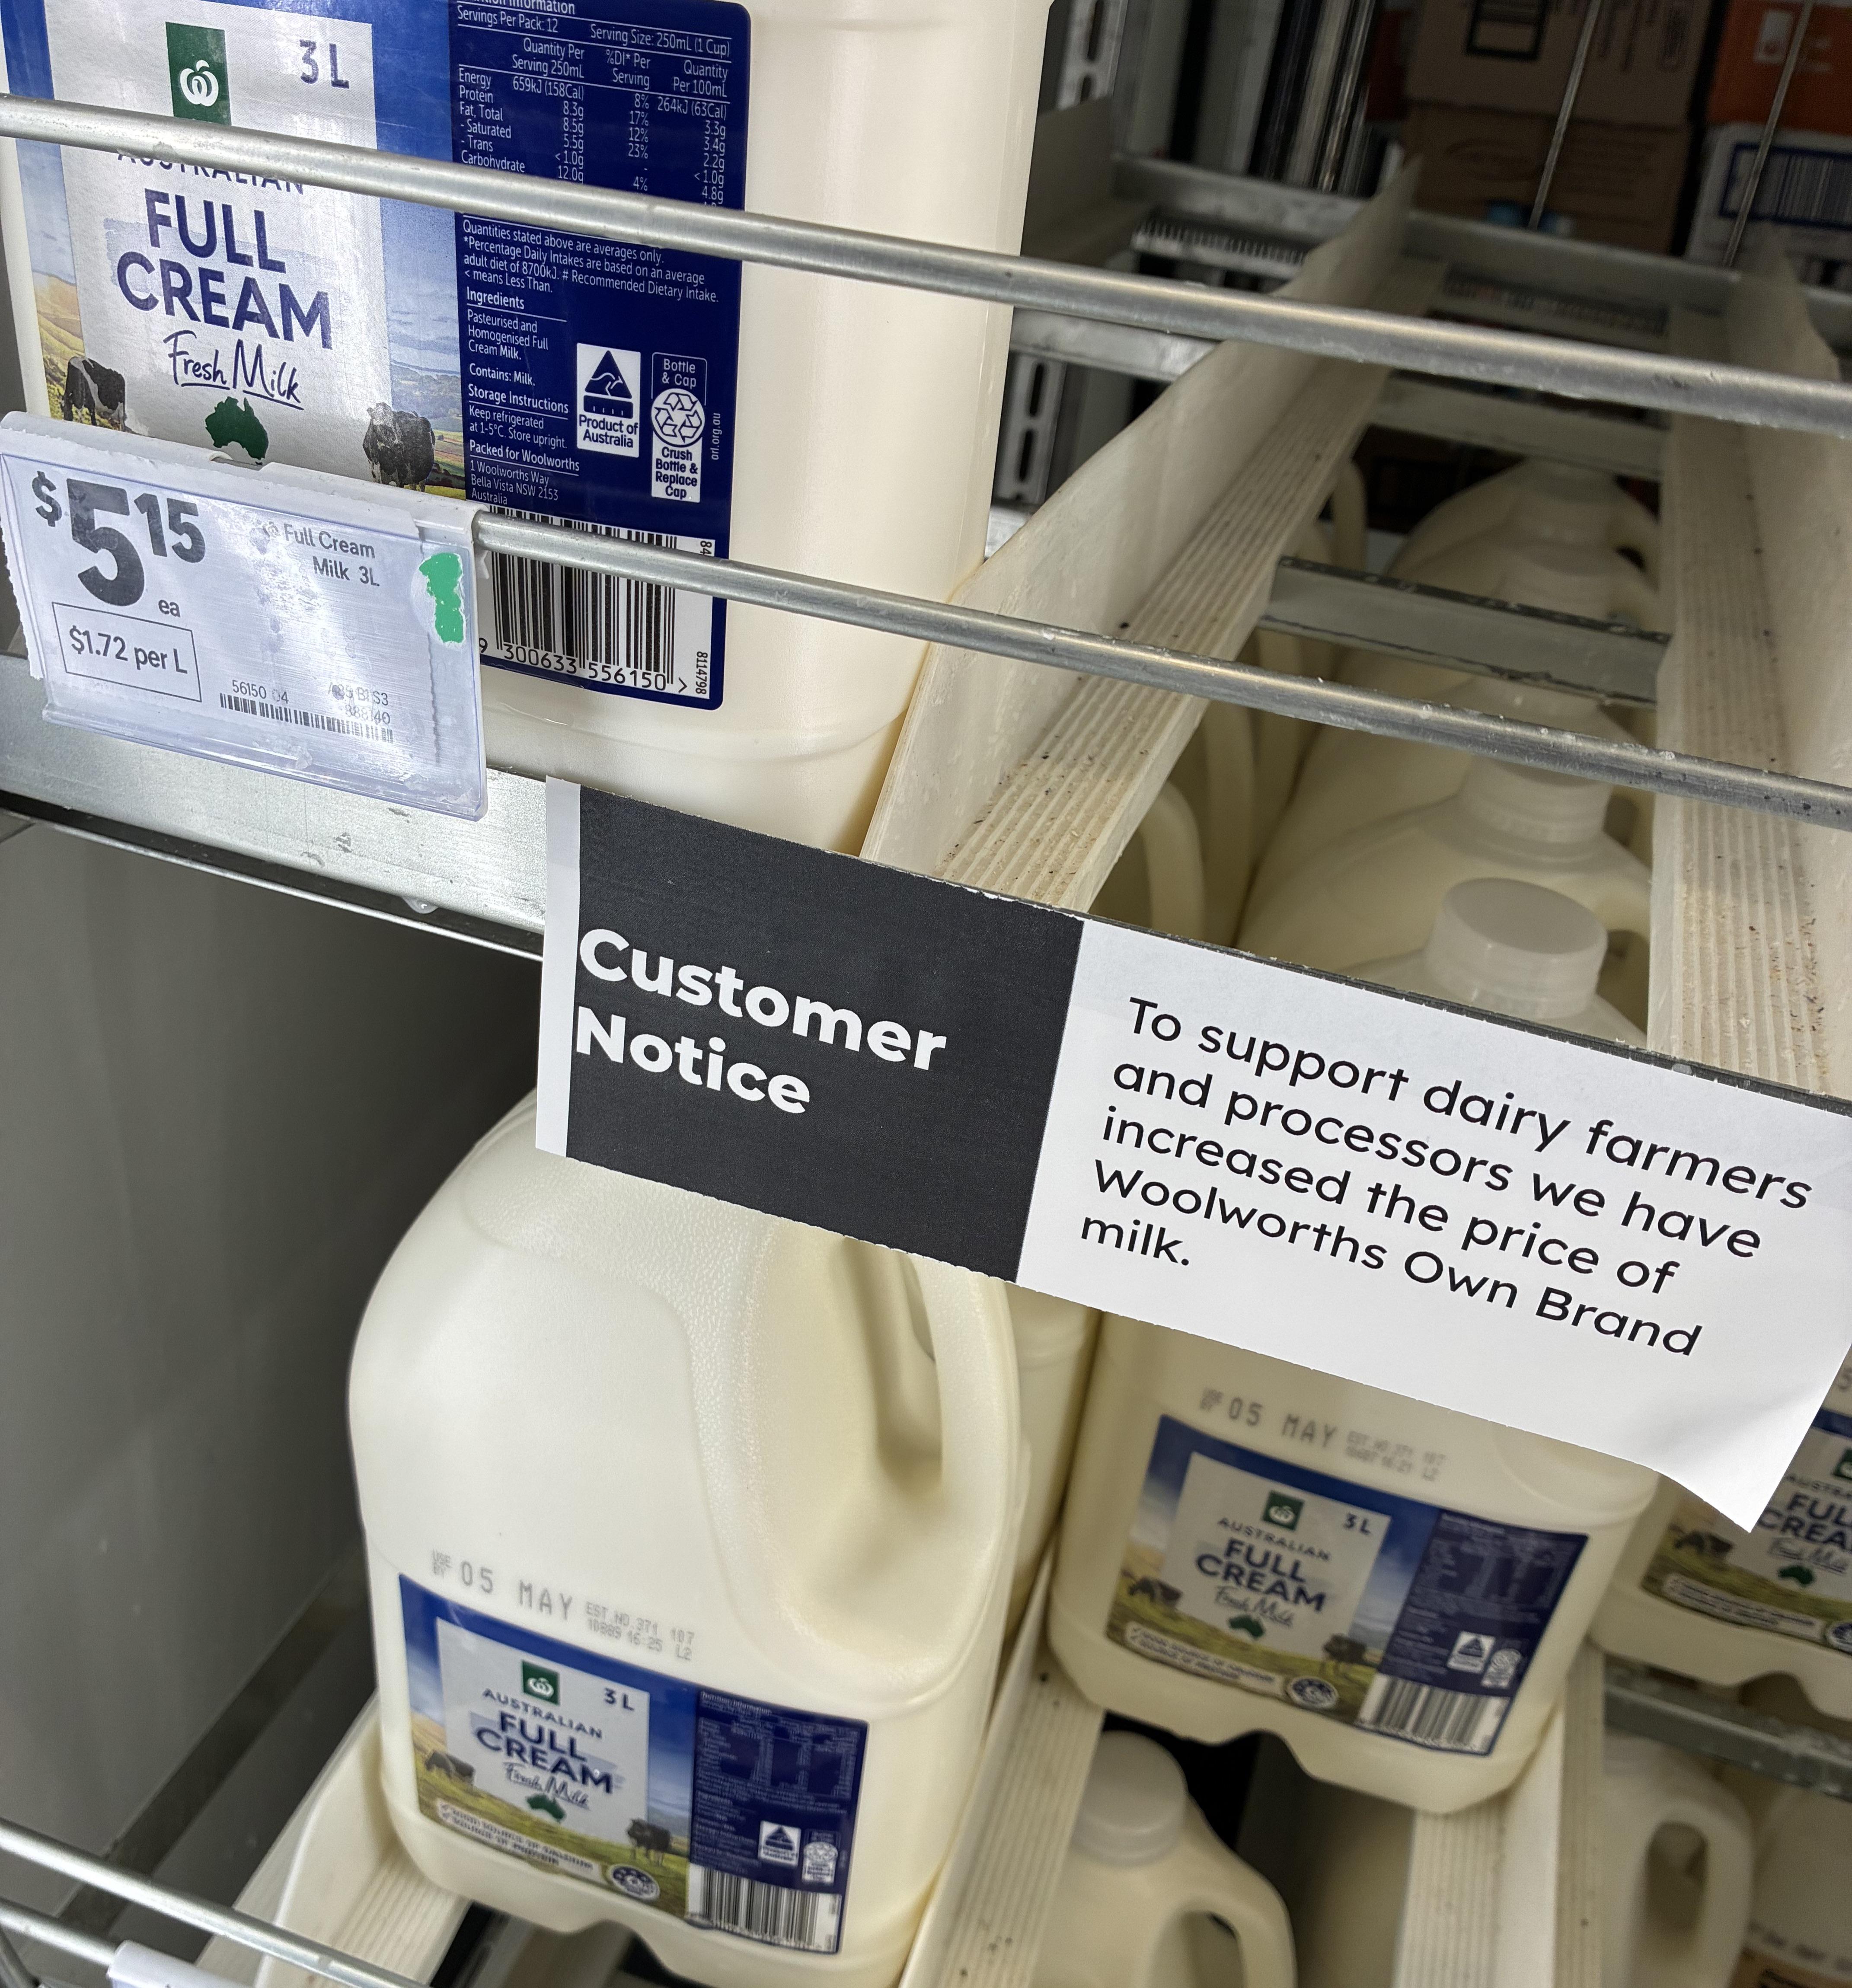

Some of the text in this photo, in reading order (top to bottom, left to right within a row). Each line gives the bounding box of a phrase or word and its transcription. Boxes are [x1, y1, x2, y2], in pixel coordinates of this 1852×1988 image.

[457, 5, 558, 33] Servings Per Pack: 12
[524, 37, 584, 60] Quantity Per
[591, 24, 730, 58] Serving Size: 250mL Cup)
[512, 54, 584, 78] Serving 250mL
[634, 53, 651, 69] Per
[684, 60, 728, 82] Quantity
[459, 67, 726, 121] Energy 659kJ (158Cal) 8% 264kJ (63Cal)
[613, 67, 650, 90] Serving
[674, 76, 727, 97] Per 100mL
[459, 85, 726, 140] Protein 8.3g 17% 3.3g
[460, 101, 725, 156] Fat, Total 8.5g 12% 3.4g
[467, 118, 725, 172] Saturated 5.5g 23% 2.2g
[467, 135, 724, 188] Trans 1.0g 1.0g
[461, 150, 723, 204] Carbohydrate 12.0g 4% 4.8g
[144, 188, 286, 274] FULL
[463, 219, 664, 266] Quantities stated above averages only.
[464, 253, 719, 302] adult diet 8700kJ. Recommended Dietary Intake.
[473, 270, 552, 293] means Less Than.
[524, 245, 547, 265] Daily
[550, 250, 584, 268] Intakes
[604, 258, 632, 274] based
[665, 270, 705, 287] average
[117, 250, 332, 349] CREAM
[466, 286, 524, 310] Ingredients
[467, 309, 537, 333] Pasteurised and
[468, 324, 549, 350] Homogenised Full
[163, 329, 301, 403] Fresh Milk
[469, 339, 521, 360] Cream Milk.
[664, 358, 696, 374] Bottle
[469, 363, 535, 386] Contains: Milk.
[674, 373, 696, 390] Cap
[468, 383, 569, 414] Storage Instructions
[469, 405, 544, 429] Keep refrigerated
[579, 414, 639, 435] Product of
[508, 427, 531, 442] Store
[533, 434, 568, 450] upright.
[583, 428, 634, 448] Australia
[710, 412, 722, 460] arl.org.au
[469, 439, 580, 471] Packed for Woolworths
[655, 458, 687, 473] Bottle
[661, 446, 693, 461] Crush
[471, 474, 559, 501] Bella Vista NSW 2153
[477, 461, 549, 488] Woolworths Way
[655, 471, 698, 487] Replace
[472, 488, 508, 505] Australia
[665, 485, 687, 500] Cap
[283, 523, 316, 547] Full
[318, 530, 375, 558] Cream
[312, 555, 350, 581] Milk
[158, 599, 181, 618] ea
[69, 625, 188, 674] $1.72 per L
[503, 641, 666, 691] 300633 556150
[232, 679, 267, 699] 56150
[695, 651, 708, 695] 8114798
[578, 928, 947, 1072] Customer
[576, 1005, 810, 1115] Notice
[1129, 996, 1812, 1209] To support dairy farmers
[1113, 1063, 1760, 1258] and processors we have
[1103, 1105, 1680, 1294] increased the price of
[1081, 1216, 1189, 1266] milk.
[1095, 1159, 1703, 1356] Woolworths Own Brand
[1228, 1396, 1264, 1427] 05
[1281, 1412, 1339, 1448] MAY
[1786, 1493, 1852, 1527] FUL
[1217, 1516, 1331, 1561] AUSTRALIAN
[1758, 1507, 1852, 1554] CREA
[1225, 1538, 1306, 1583] FULL
[461, 1561, 573, 1620] 05 MAY
[1196, 1553, 1327, 1613] CREAM
[482, 1688, 603, 1739] AUSTRALIAN
[499, 1710, 587, 1762] FULL
[476, 1726, 613, 1794] CREAM
